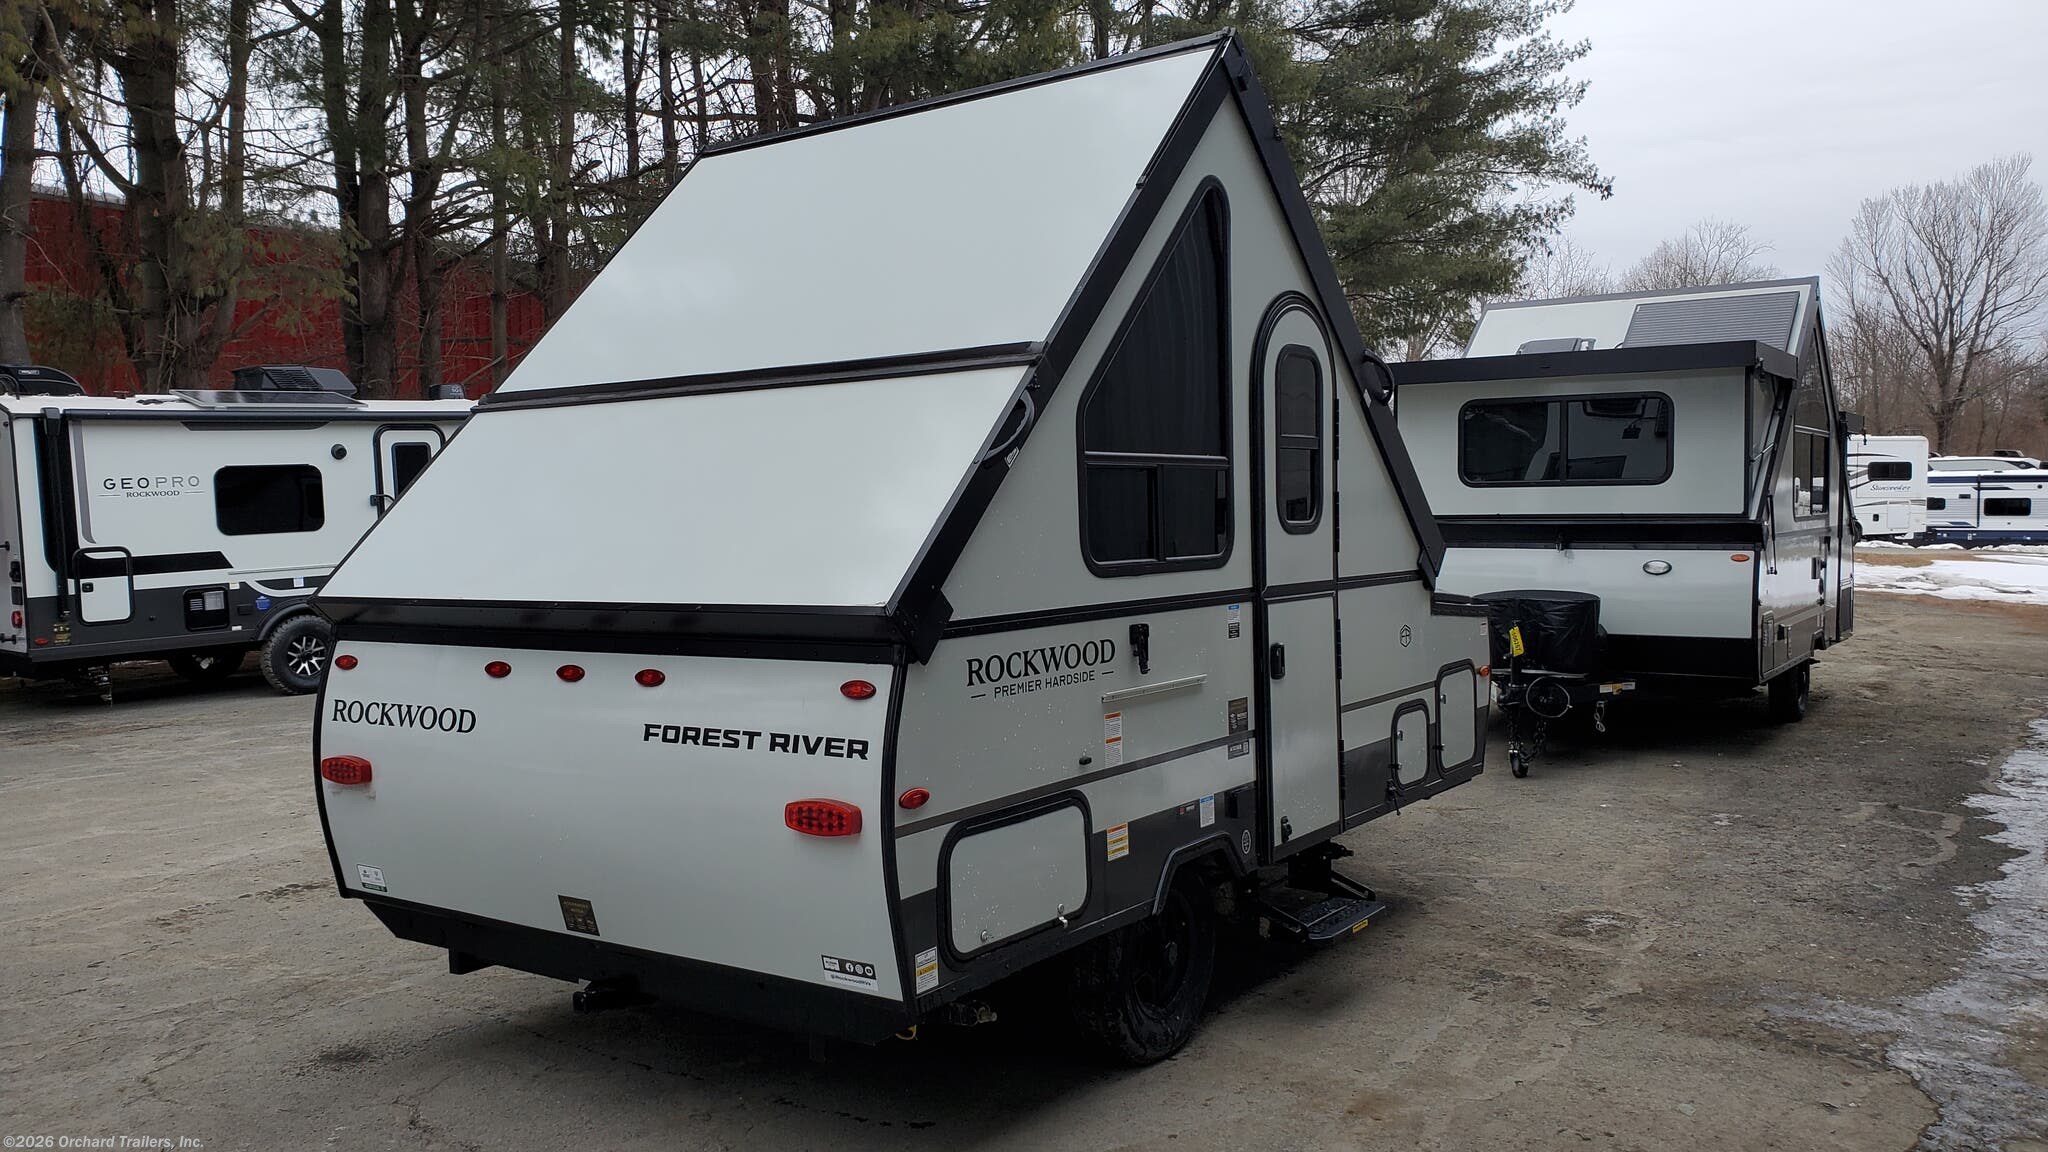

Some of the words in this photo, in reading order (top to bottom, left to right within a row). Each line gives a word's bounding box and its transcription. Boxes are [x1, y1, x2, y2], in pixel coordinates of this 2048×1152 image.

[126, 490, 180, 498] ROCKWOOD
[966, 638, 1116, 687] ROCKWOOD
[994, 679, 1042, 698] PREMIER
[1045, 670, 1096, 689] HARDSIDE
[332, 699, 477, 734] ROCKWOOD
[644, 724, 763, 751] FOREST
[769, 733, 870, 761] RIVER
